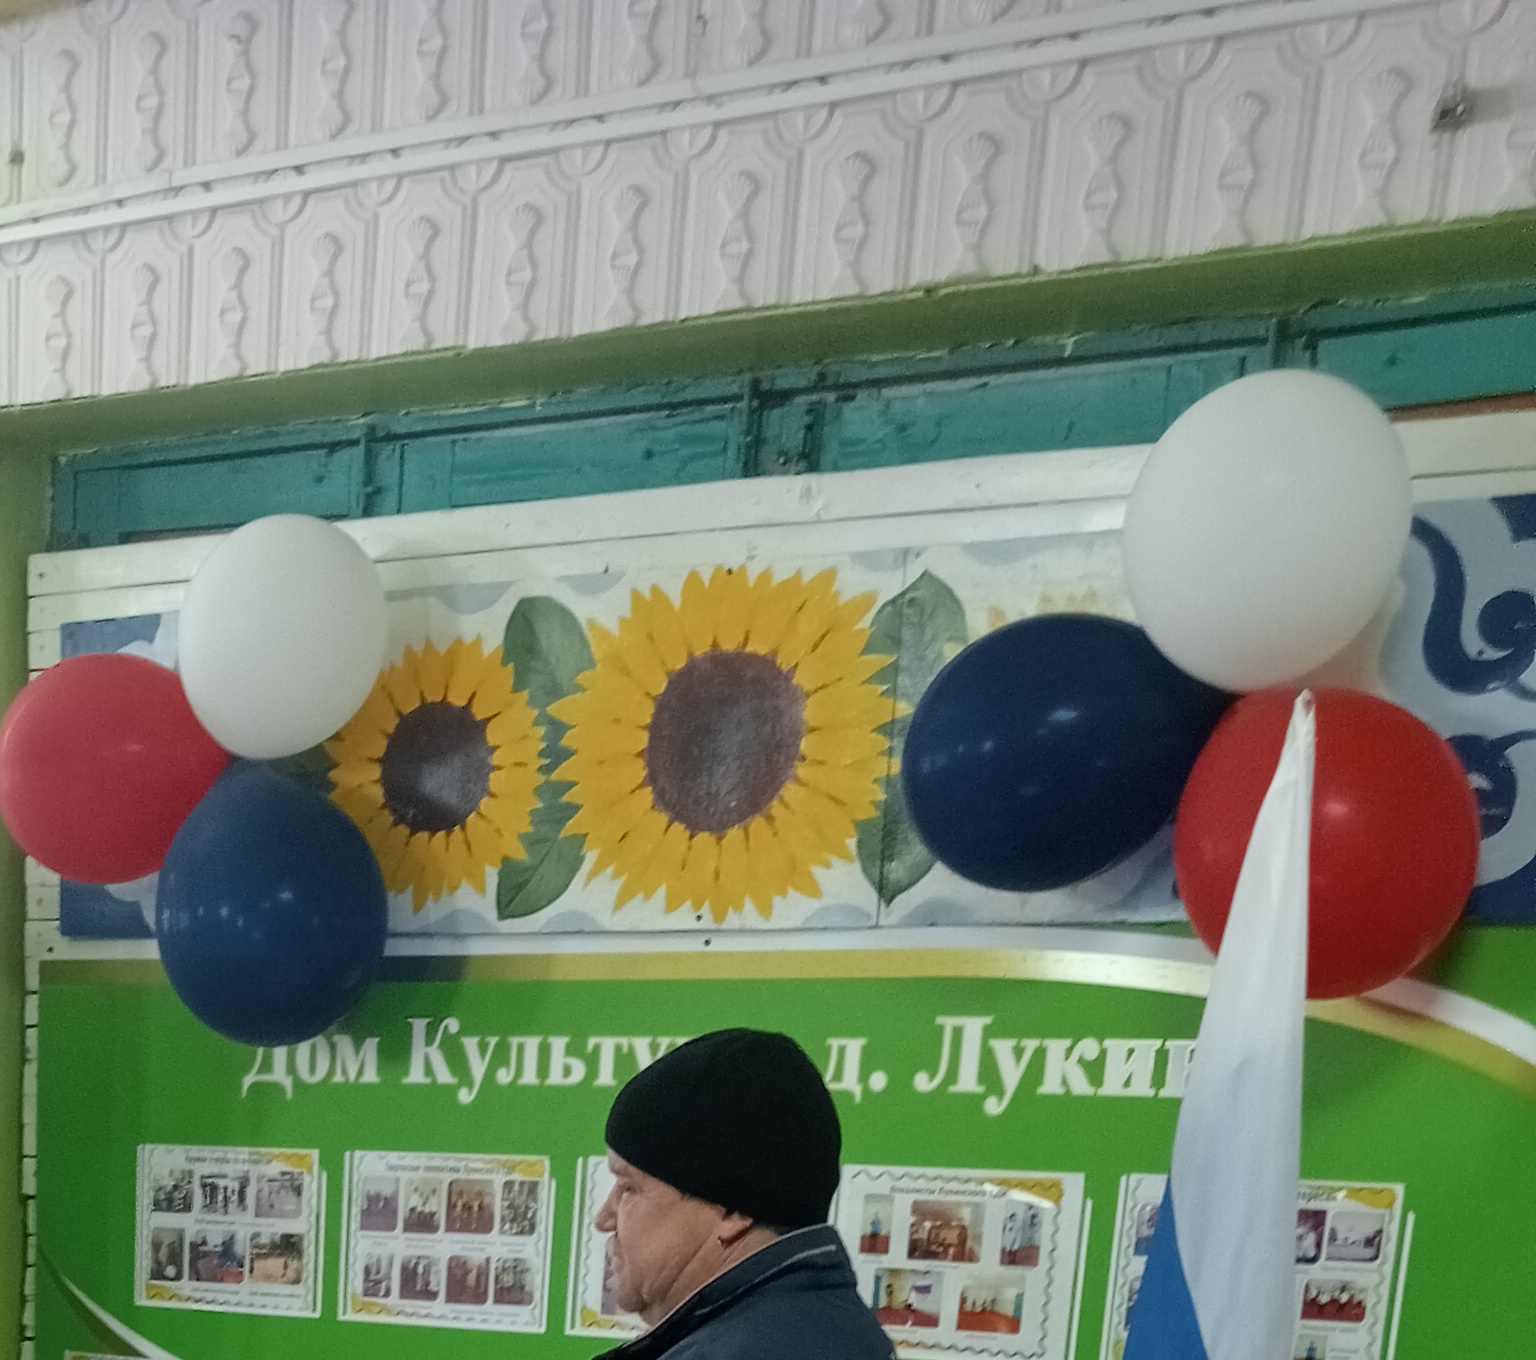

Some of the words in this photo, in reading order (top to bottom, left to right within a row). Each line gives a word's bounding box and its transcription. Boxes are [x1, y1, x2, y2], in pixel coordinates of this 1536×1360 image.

[241, 1034, 381, 1100] Дом
[401, 1016, 692, 1105] Культу
[826, 1036, 889, 1103] д.
